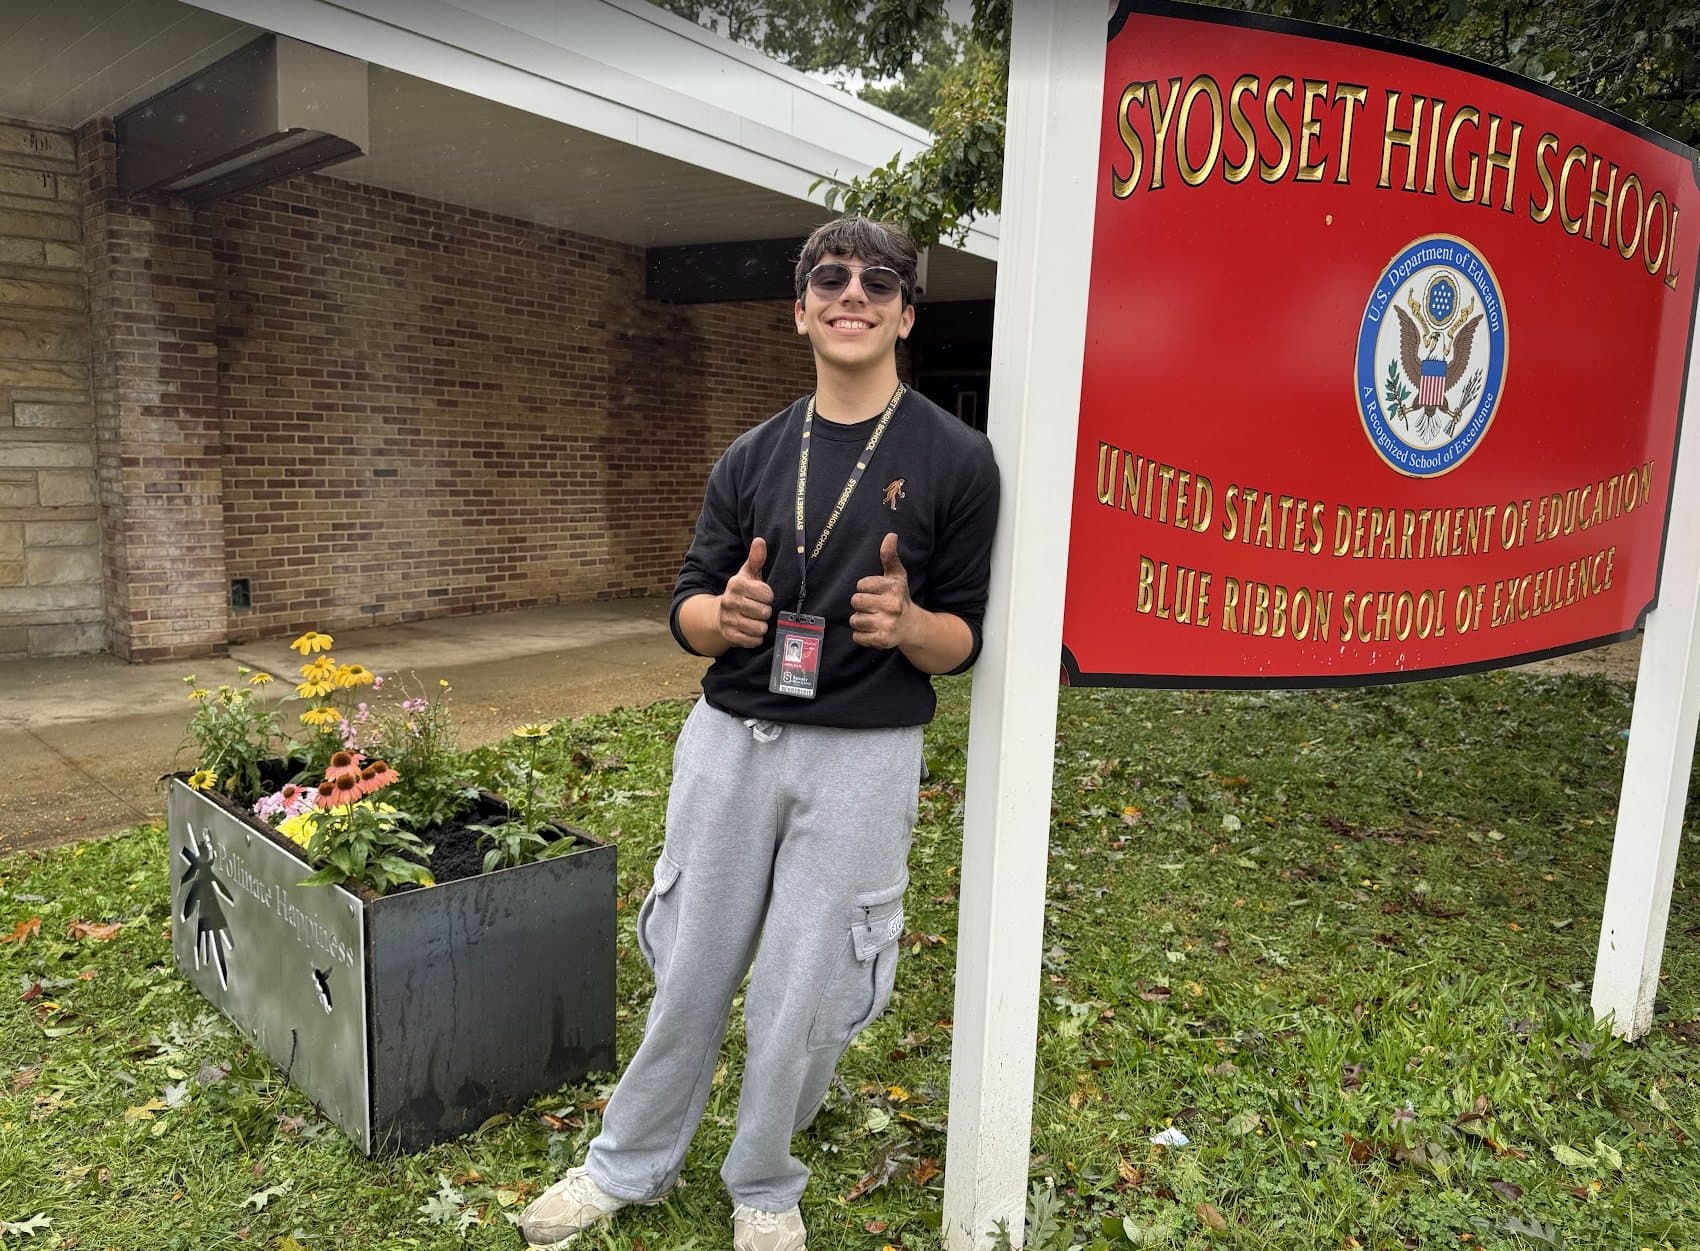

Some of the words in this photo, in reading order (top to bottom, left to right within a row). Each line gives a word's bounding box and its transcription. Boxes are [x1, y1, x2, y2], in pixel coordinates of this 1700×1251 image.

[1112, 74, 1368, 199] SYOSSET
[1376, 90, 1523, 212] HIGH
[1529, 133, 1679, 290] SCHOOL
[1368, 289, 1391, 323] U.S.
[1388, 247, 1454, 287] Department
[1455, 253, 1470, 268] of
[1467, 259, 1500, 332] Education
[1363, 386, 1373, 399] A
[882, 407, 894, 424] HIGH
[1366, 401, 1408, 463] Recognized
[1454, 393, 1494, 455] Excellence
[866, 423, 886, 452] SCHOOL
[799, 448, 809, 478] SCHOOL
[1409, 453, 1441, 469] School
[1443, 449, 1455, 463] of
[837, 478, 857, 512] SYOSSET
[1096, 440, 1214, 534] UNITED
[1222, 483, 1325, 555] STATES
[1332, 504, 1497, 560] DEPARTMENT
[1501, 500, 1532, 551] OF
[1535, 460, 1656, 543] EDUCATION
[796, 497, 804, 531] SYOSSET
[827, 509, 841, 530] HIGH
[811, 528, 830, 559] SCHOOL
[1136, 554, 1213, 628] BLUE
[1221, 576, 1335, 643] RIBBON
[1340, 589, 1447, 643] SCHOOL
[1455, 584, 1487, 635] OF
[1490, 546, 1617, 629] EXCELLENCE
[218, 842, 273, 909] Pollinate
[275, 884, 355, 969] Happiness
